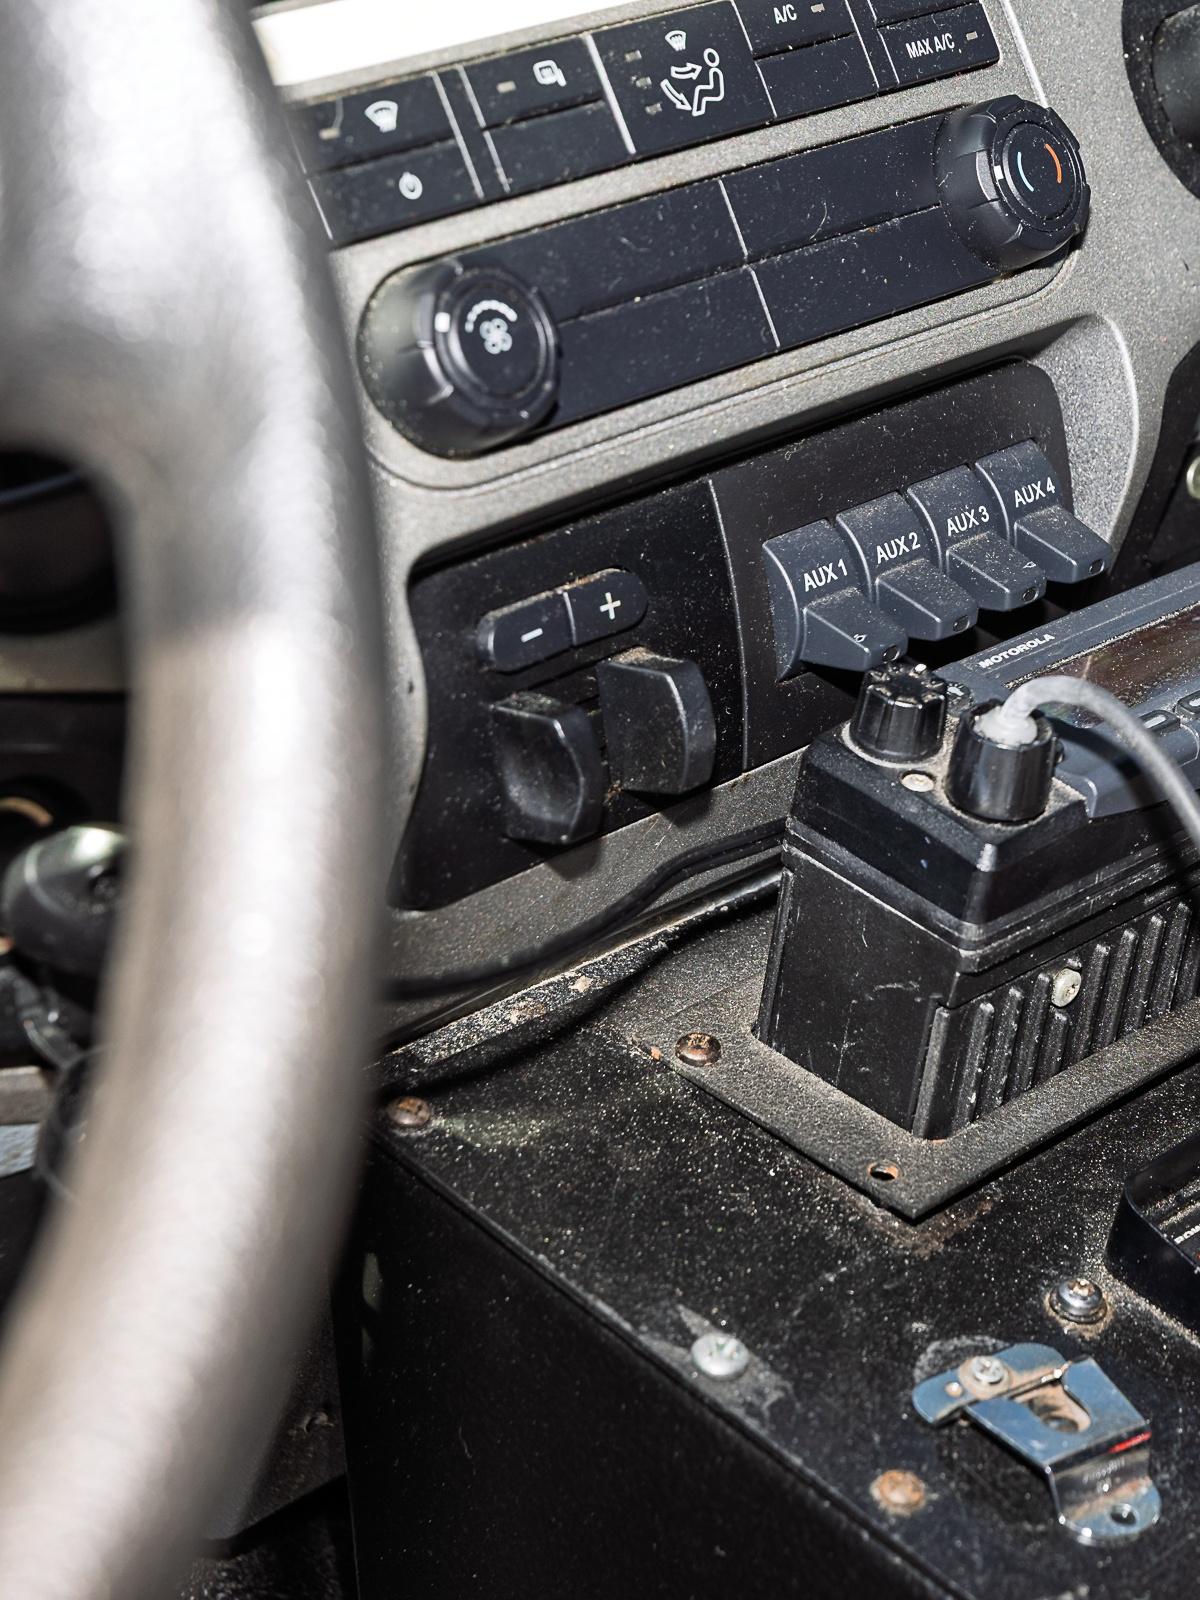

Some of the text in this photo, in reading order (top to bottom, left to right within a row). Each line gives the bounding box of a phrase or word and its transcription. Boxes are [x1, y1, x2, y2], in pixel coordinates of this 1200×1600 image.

[774, 4, 798, 24] A/C
[906, 33, 955, 58] MAX A/C
[1013, 477, 1055, 508] AUX 4
[947, 505, 990, 536] AUX 3
[876, 531, 921, 564] AUX 2
[803, 558, 848, 592] AUX 1
[979, 633, 1055, 668] MOTOROLA
